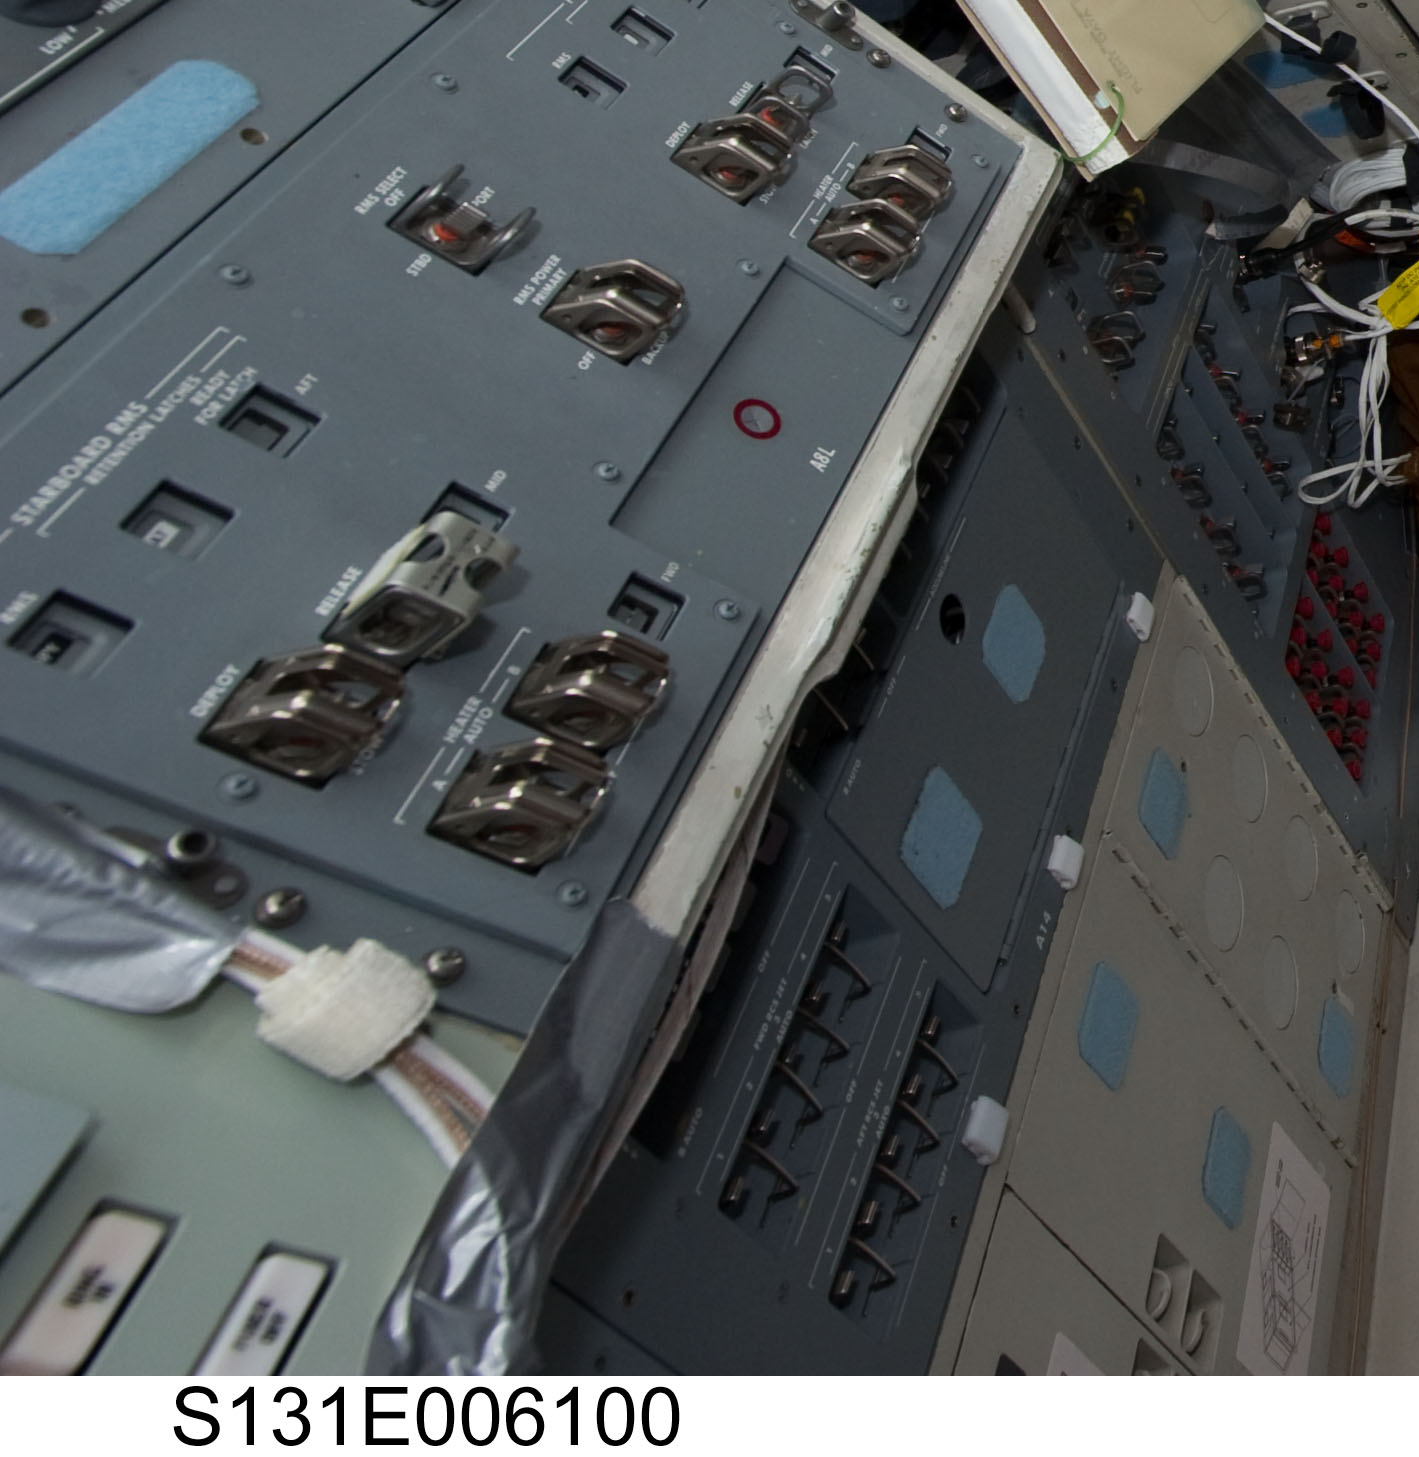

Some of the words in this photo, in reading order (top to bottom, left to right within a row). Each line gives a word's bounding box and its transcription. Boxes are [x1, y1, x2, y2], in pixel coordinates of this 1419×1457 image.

[39, 30, 74, 55] LOW
[820, 44, 834, 57] MID
[552, 52, 572, 70] RMS
[729, 80, 754, 107] RELEASE
[664, 121, 692, 149] DEPLOY
[935, 122, 949, 138] FWD
[354, 193, 380, 215] RMS
[375, 166, 408, 194] SELECT
[385, 188, 406, 208] OFF
[813, 174, 834, 200] HEATER
[824, 182, 842, 204] AUTO
[405, 253, 432, 277] STBD
[513, 284, 534, 307] RMS
[530, 253, 562, 285] POWER
[531, 268, 568, 307] PRIMARY
[578, 350, 596, 371] OFF
[190, 368, 230, 406] READY
[194, 400, 222, 426] FOR
[221, 366, 258, 401] LATCH
[295, 372, 318, 395] AFT
[83, 421, 155, 486] RETENTION
[150, 375, 202, 423] LATCHES
[10, 434, 112, 526] STARBOARD
[105, 400, 149, 435] RMS
[809, 445, 837, 473] A8L
[484, 469, 507, 493] MID
[661, 562, 680, 583] FWD
[315, 565, 364, 617] RELEASE
[0, 591, 39, 624] RMS
[190, 664, 241, 719] DEPLOY
[444, 696, 483, 744] HEATER
[464, 708, 493, 744] AUTO
